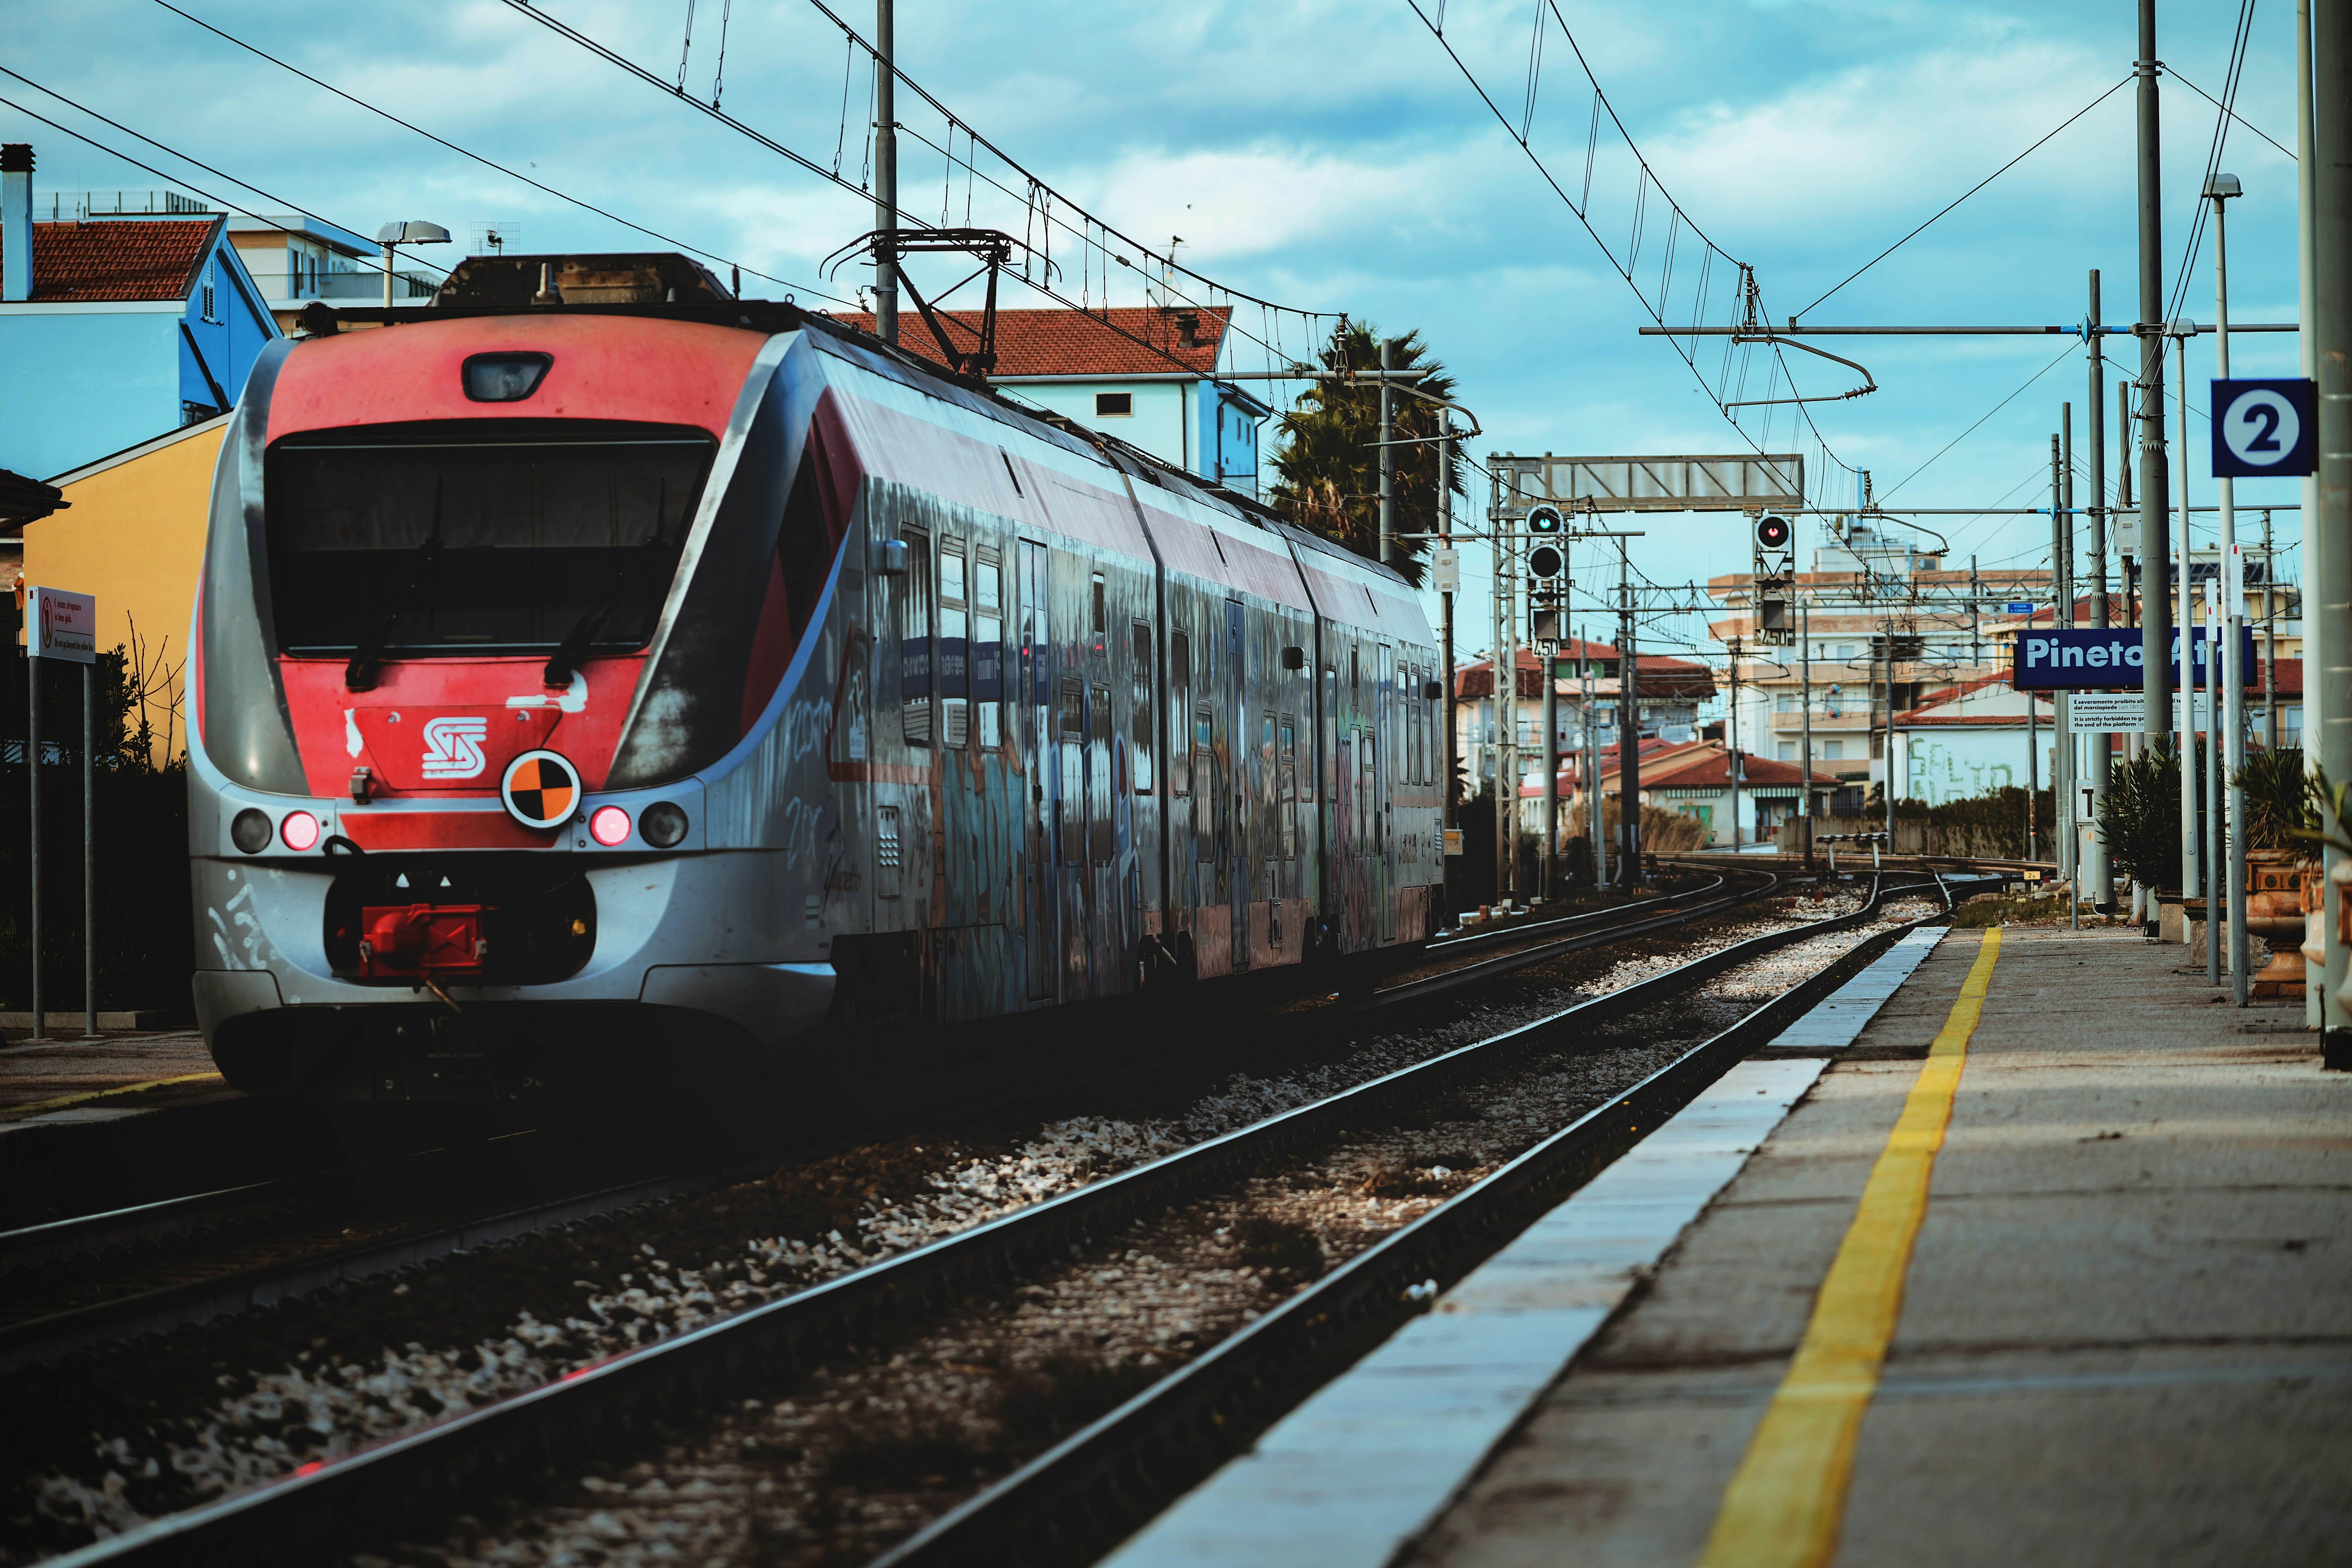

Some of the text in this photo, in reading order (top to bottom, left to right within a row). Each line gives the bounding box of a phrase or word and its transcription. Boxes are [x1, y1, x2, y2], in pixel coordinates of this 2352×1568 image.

[2243, 403, 2281, 451] 2
[1534, 639, 1558, 656] 450
[1762, 628, 1786, 646] 450
[2027, 638, 2143, 668] Pineto
[2082, 789, 2094, 817] T
